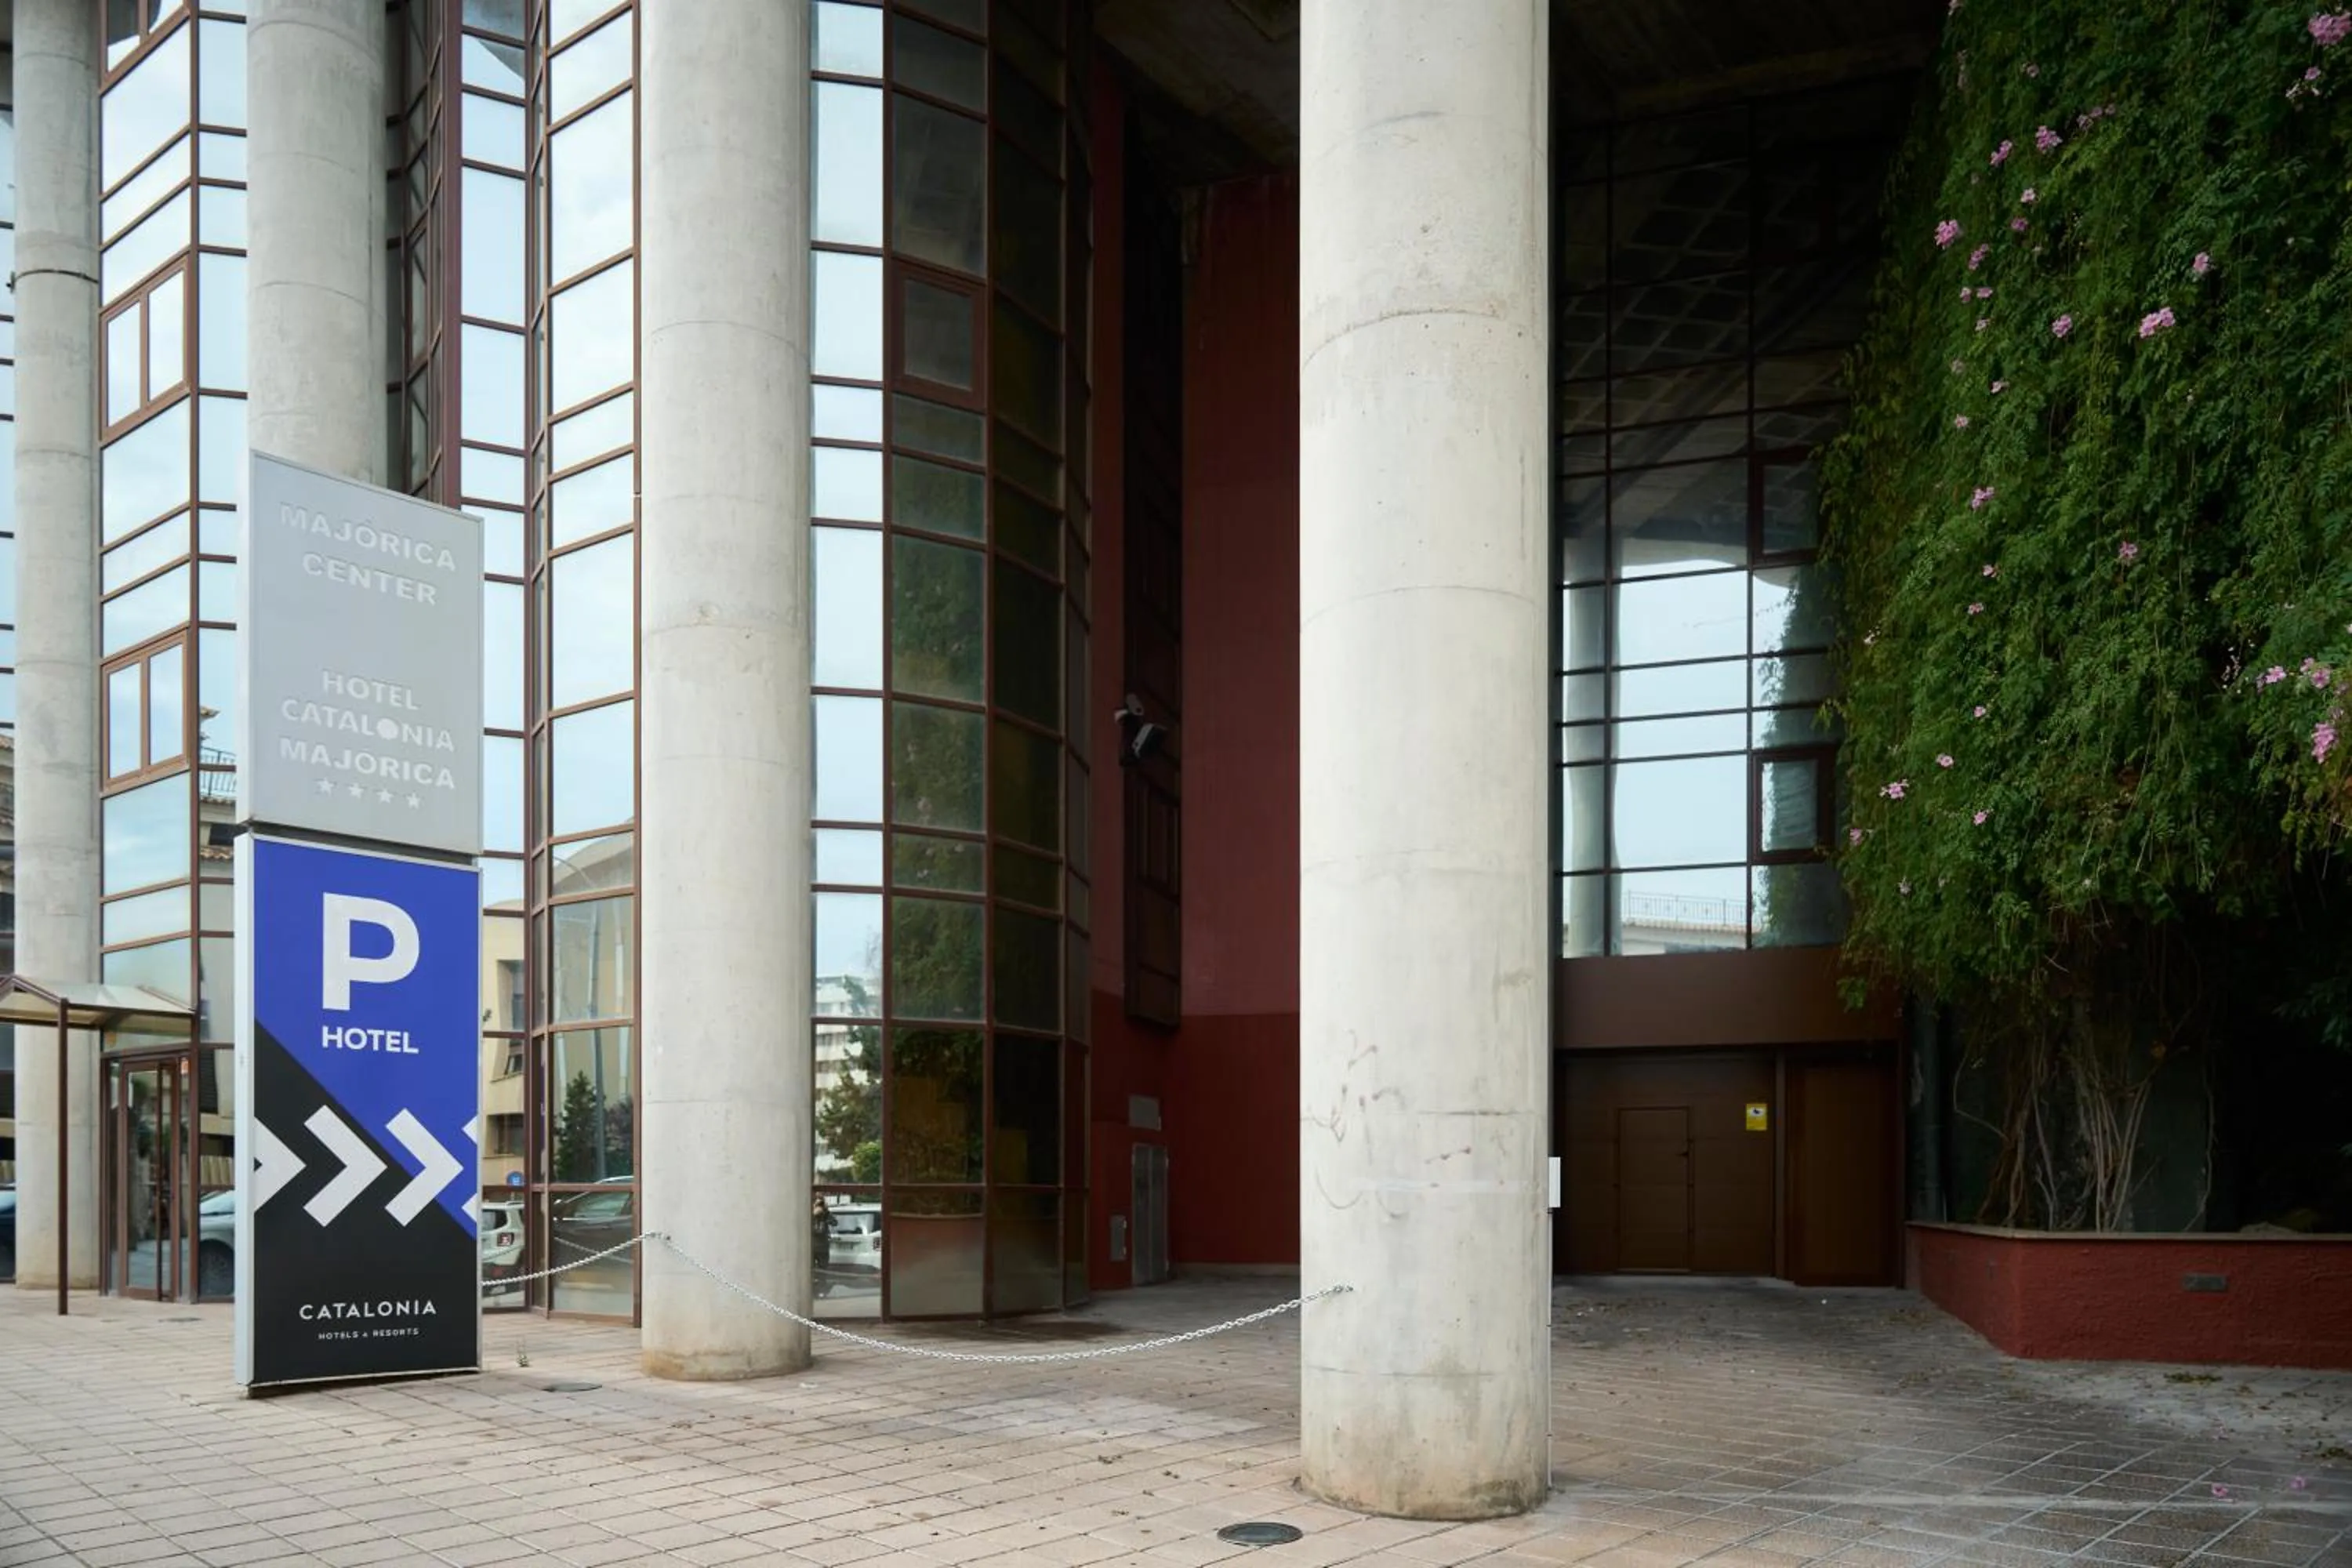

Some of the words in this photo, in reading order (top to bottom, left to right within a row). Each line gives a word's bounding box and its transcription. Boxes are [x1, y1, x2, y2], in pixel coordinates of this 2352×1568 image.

[302, 552, 437, 606] CENTER
[322, 670, 420, 710] HOTEL
[281, 699, 455, 753] CATALONIA
[322, 892, 420, 1011] P
[322, 1025, 419, 1054] HOTEL
[299, 1299, 437, 1320] CATALONIA
[318, 1330, 359, 1340] HOTELS
[372, 1327, 419, 1338] RESORTS
